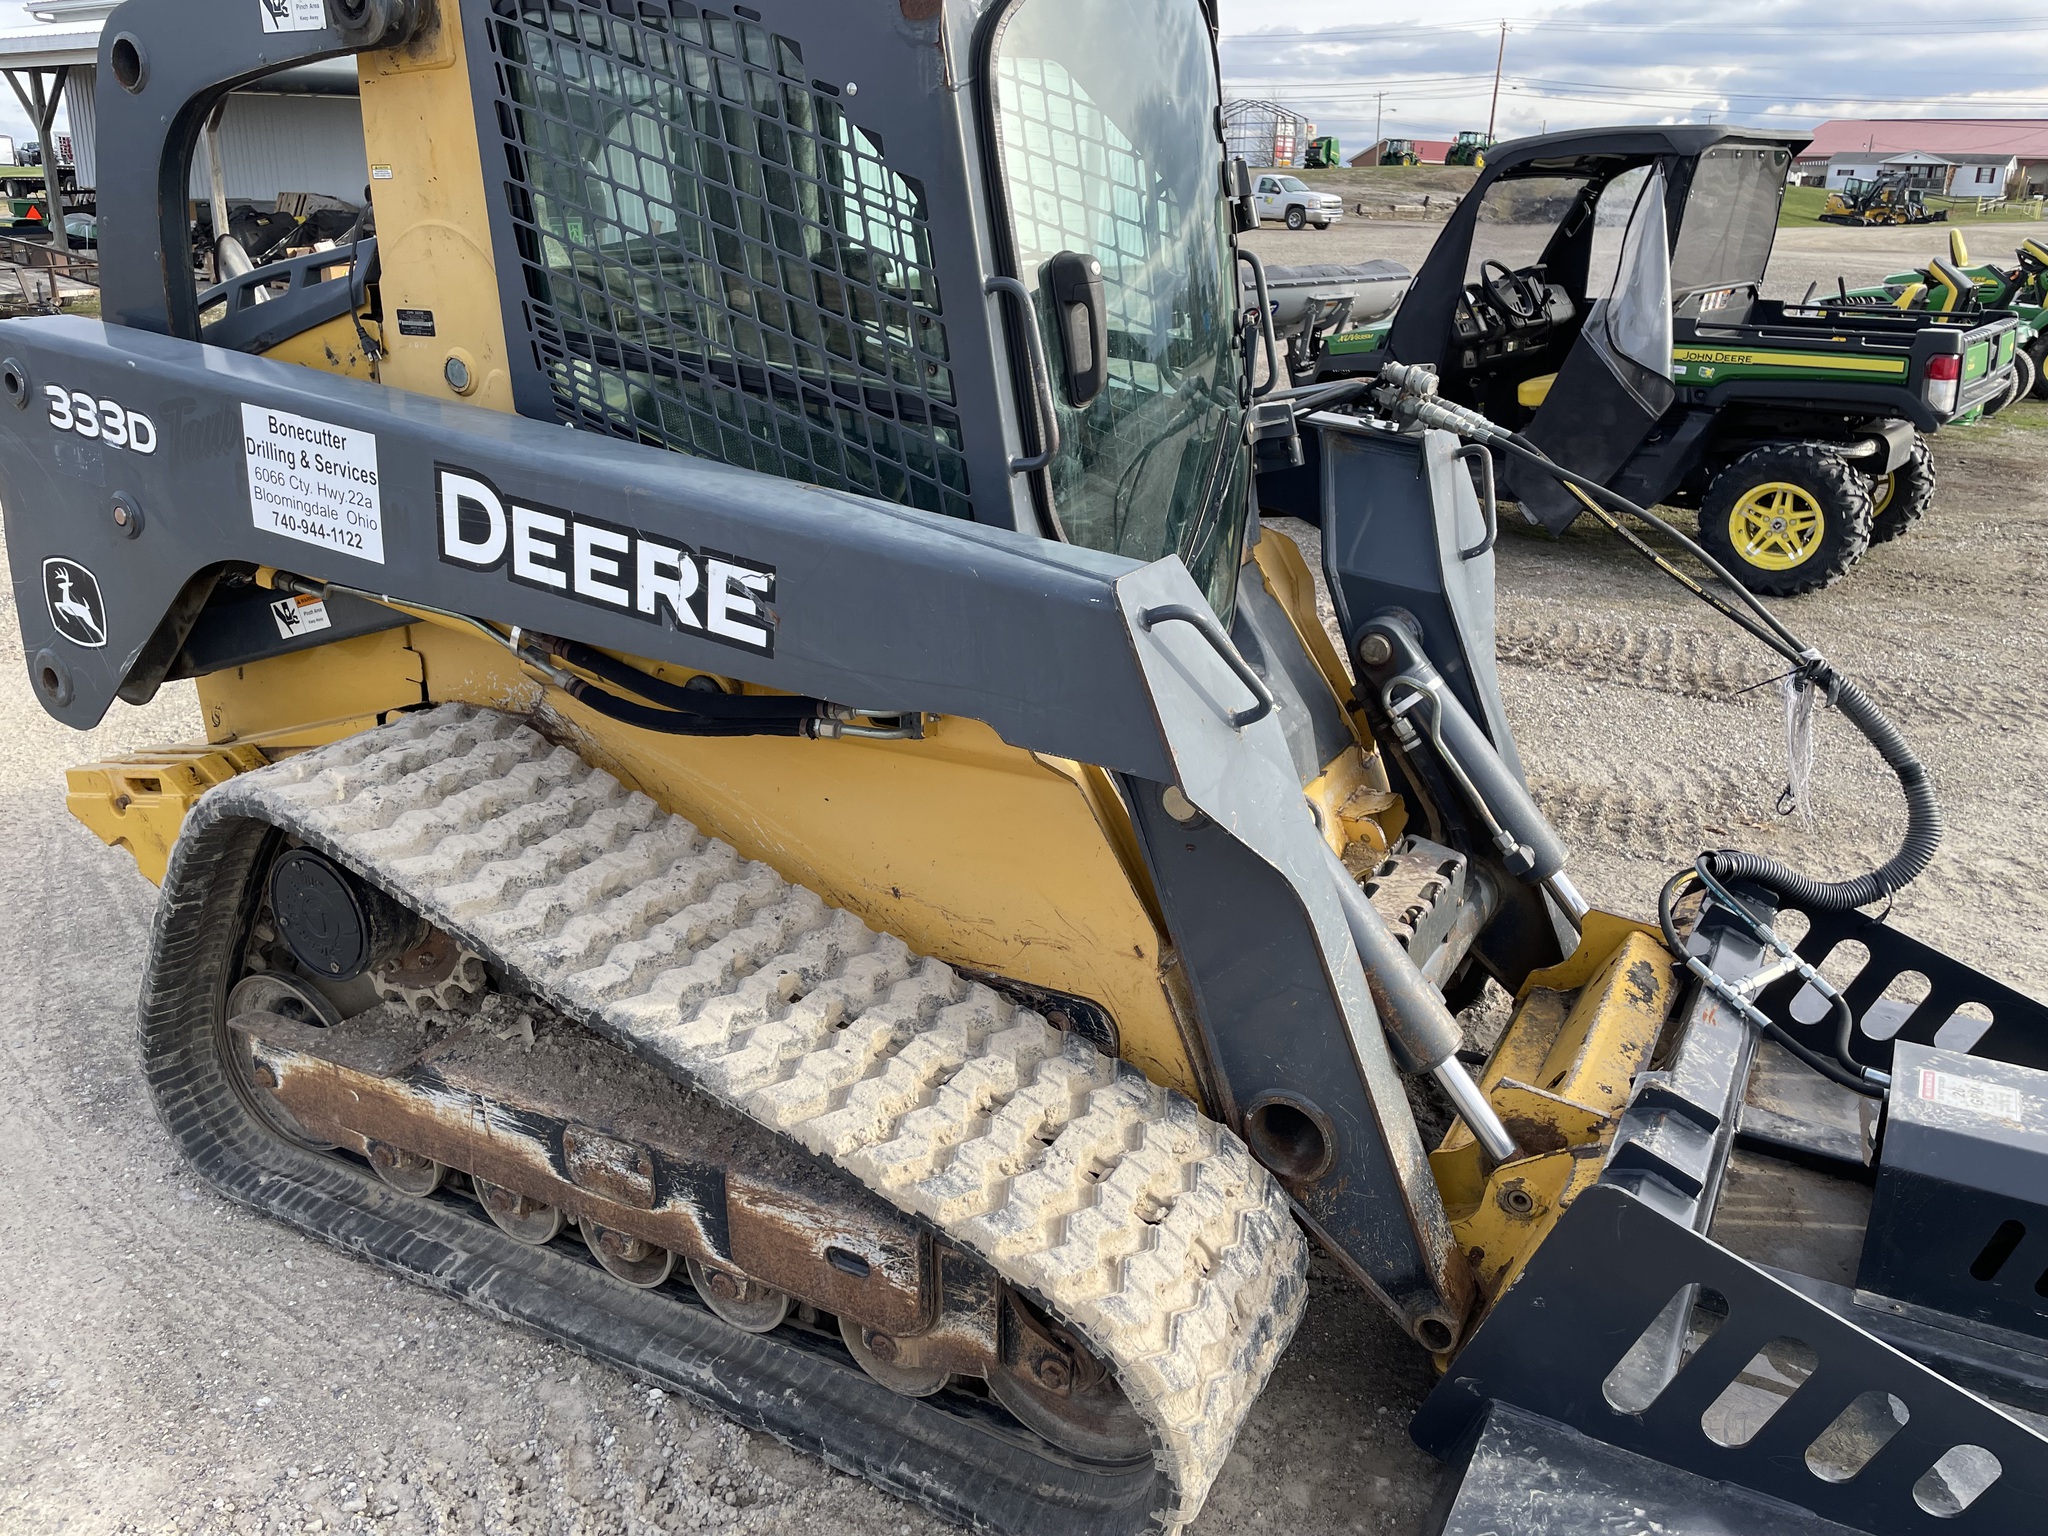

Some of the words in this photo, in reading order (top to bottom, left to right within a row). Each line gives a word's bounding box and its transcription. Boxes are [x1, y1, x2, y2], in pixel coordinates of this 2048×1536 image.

[1682, 351, 1713, 362] JOHN
[1715, 352, 1753, 363] DEERE
[44, 384, 157, 454] 333D
[268, 415, 347, 451] Bonecutter
[246, 436, 296, 470] Drilling
[300, 450, 311, 469] &
[314, 453, 377, 486] Services
[254, 466, 285, 487] 6066
[289, 475, 313, 496] Cty.
[254, 485, 339, 521] Bloomingdale
[346, 510, 378, 531] Ohio
[272, 511, 363, 550] 740-944-1122
[440, 470, 772, 648] DEERE
